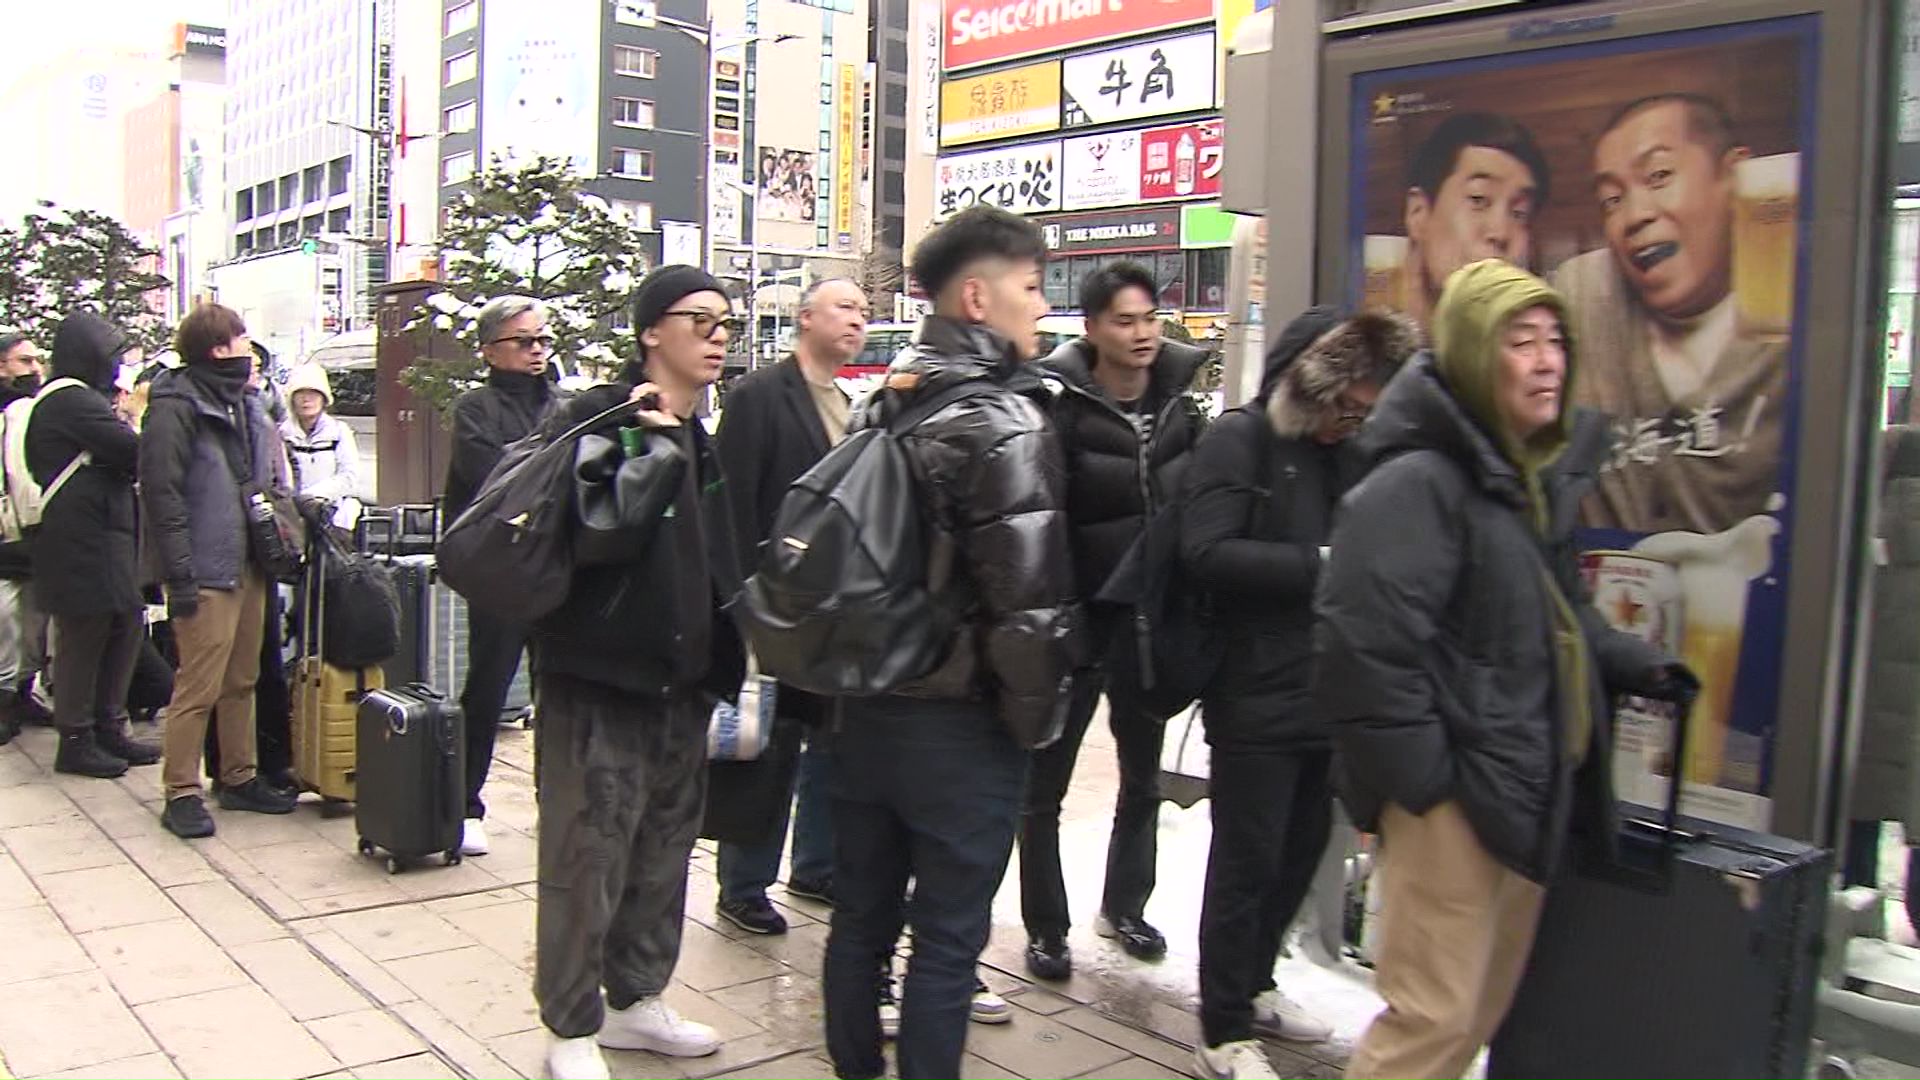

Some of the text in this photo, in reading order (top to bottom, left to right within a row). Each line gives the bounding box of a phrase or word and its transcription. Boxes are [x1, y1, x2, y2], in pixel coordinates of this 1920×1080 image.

[1099, 49, 1174, 106] 牛角
[1089, 225, 1129, 241] NIKKA
[1130, 222, 1157, 239] BAR
